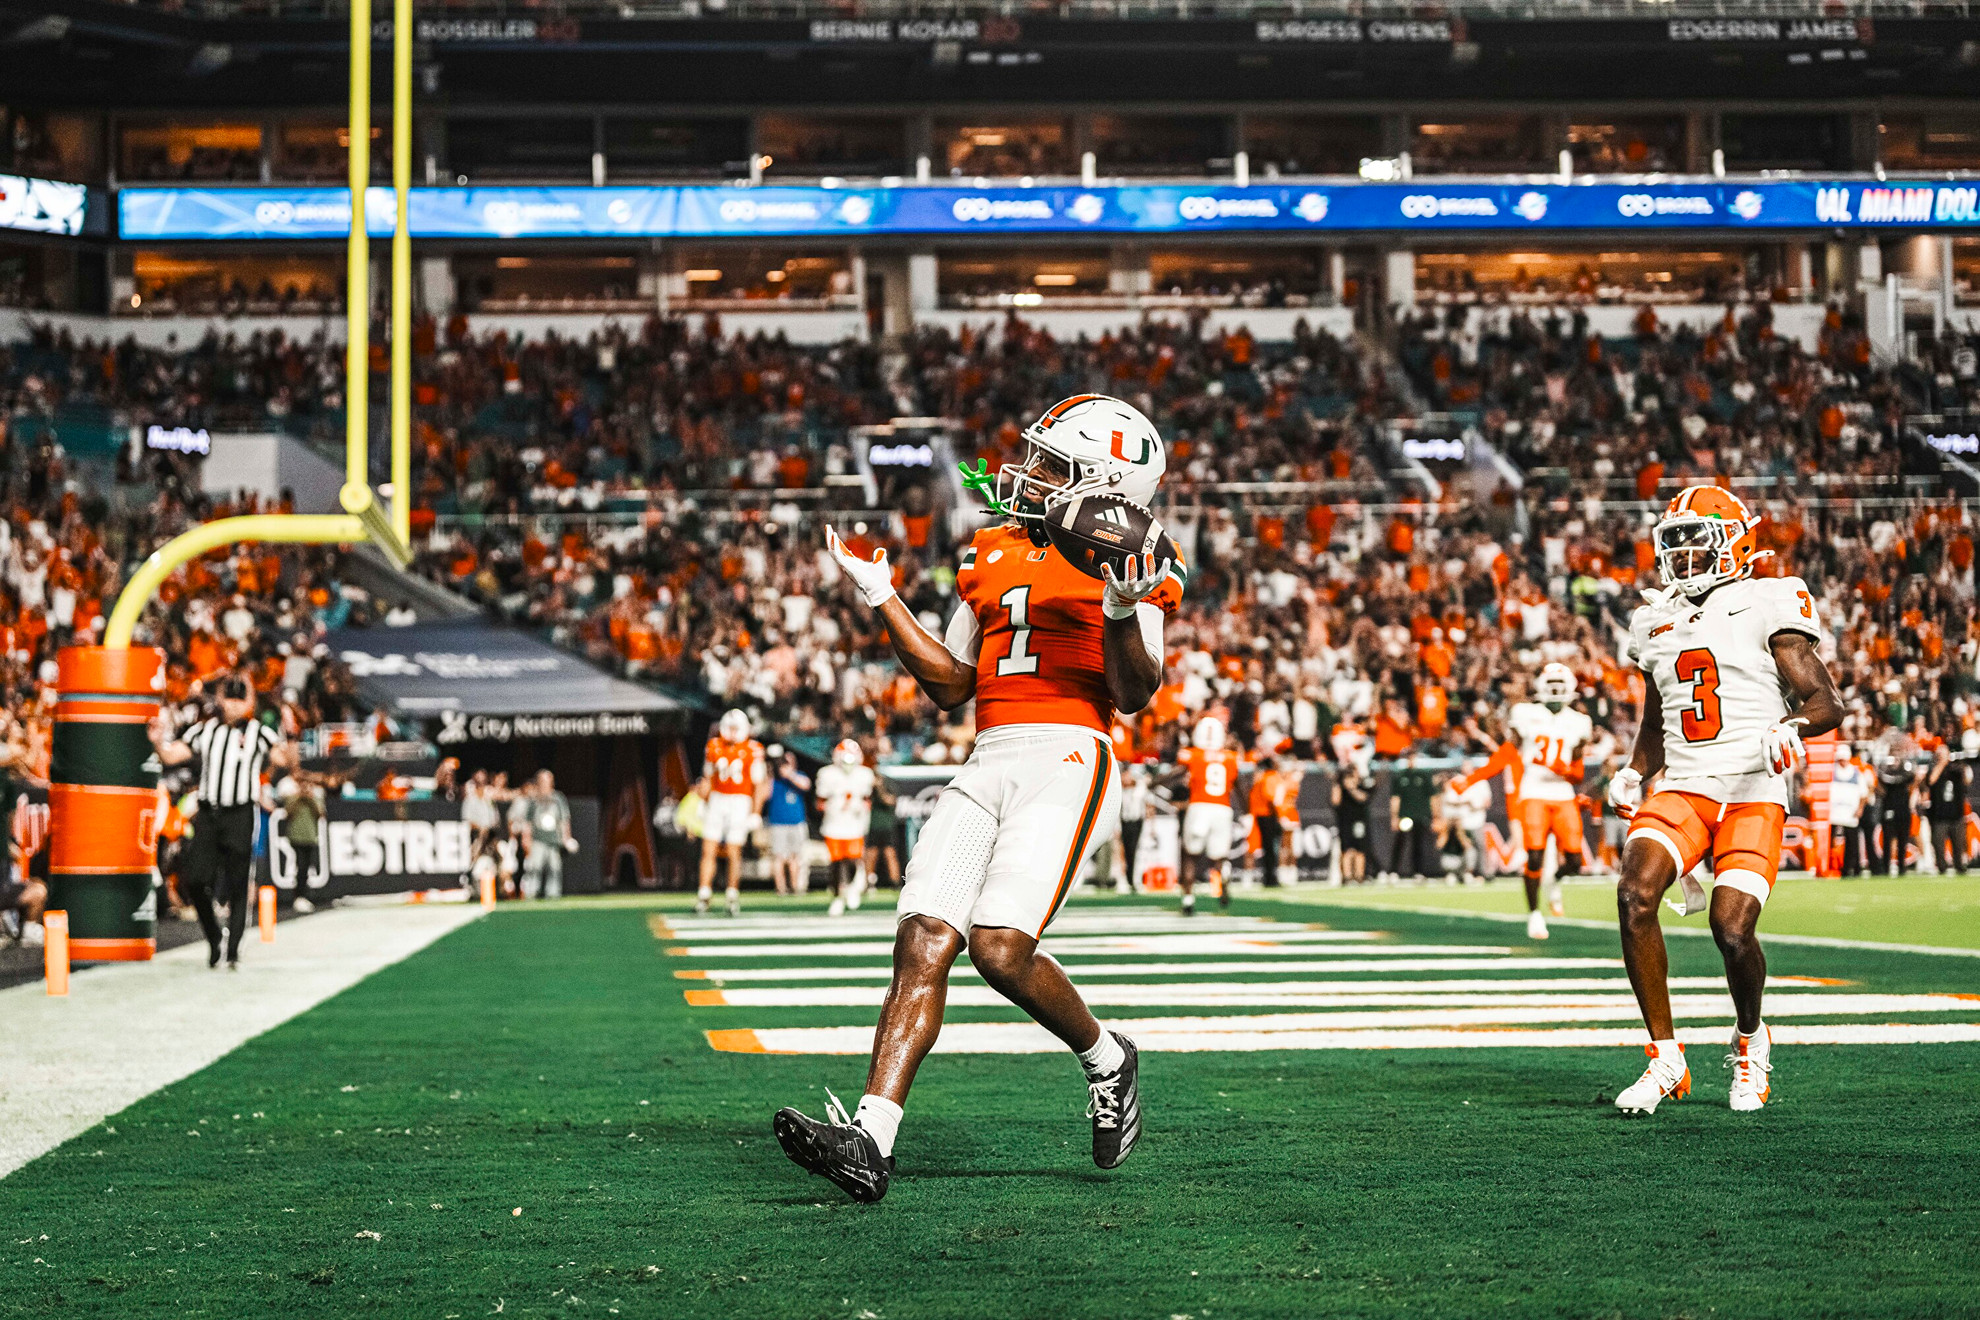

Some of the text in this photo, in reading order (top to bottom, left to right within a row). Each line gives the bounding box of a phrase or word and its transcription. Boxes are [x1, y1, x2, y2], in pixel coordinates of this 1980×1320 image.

[900, 20, 979, 40] KOSAR
[1256, 20, 1363, 41] BURGESS
[1368, 20, 1449, 41] OWENS
[1669, 20, 1780, 40] EDGERRIN
[1786, 20, 1858, 40] JAMES
[1858, 188, 1933, 222] MIAMI
[1110, 430, 1150, 465] U
[1092, 528, 1124, 544] DIME
[1797, 590, 1812, 619] 3
[996, 584, 1041, 676] 1
[1675, 647, 1721, 743] 3
[469, 712, 649, 743] City National Bank
[1533, 735, 1565, 767] 31
